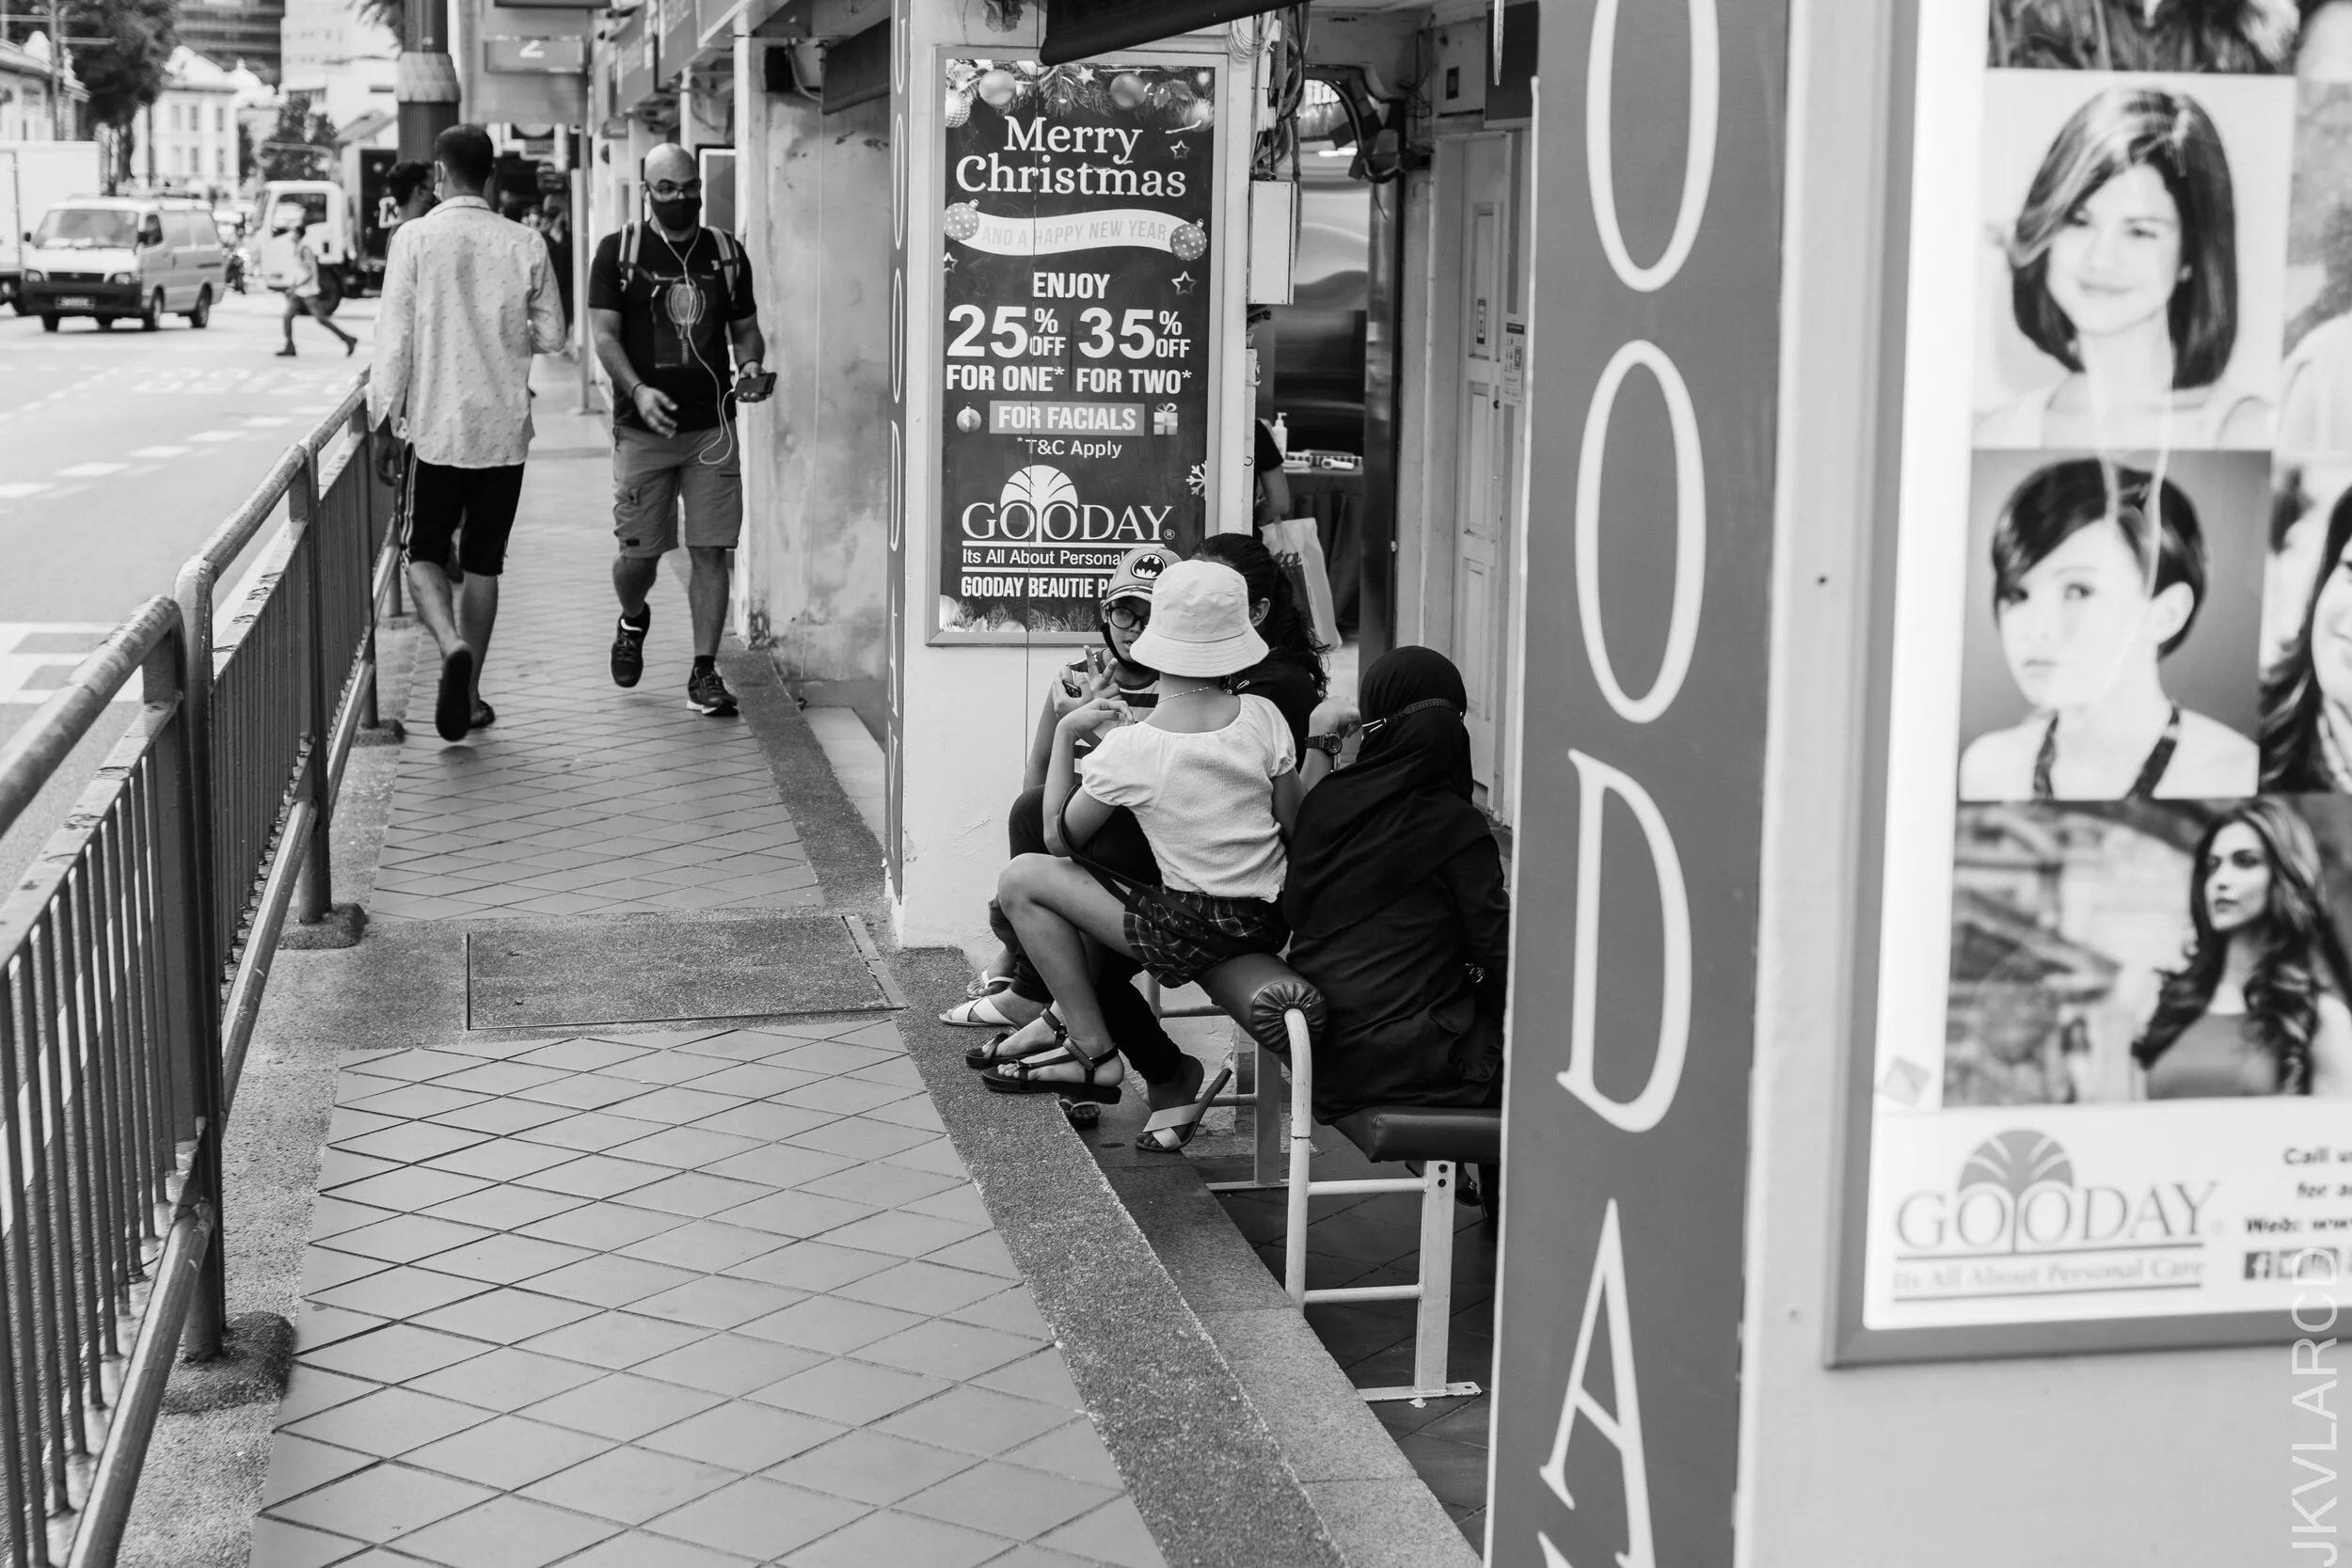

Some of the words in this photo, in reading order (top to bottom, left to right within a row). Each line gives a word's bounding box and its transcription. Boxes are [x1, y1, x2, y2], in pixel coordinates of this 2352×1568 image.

[1004, 116, 1143, 165] Merry
[956, 152, 1186, 198] Christmas
[982, 227, 1012, 246] AND
[1017, 230, 1027, 246] A
[1033, 224, 1084, 245] HAPPY
[1089, 219, 1122, 240] NEW
[1129, 219, 1167, 242] YEAR
[1033, 272, 1110, 299] ENJOY
[1029, 336, 1066, 356] OFF
[1155, 338, 1191, 358] OFF
[946, 365, 995, 391] FOR
[1076, 368, 1121, 393] FOR
[998, 405, 1041, 429] FOR
[1047, 406, 1136, 431] FACIALS
[1071, 440, 1122, 458] Apply
[963, 548, 981, 563] Its
[986, 549, 1005, 564] All
[1009, 549, 1055, 565] About
[1060, 549, 1124, 565] Personal
[961, 576, 1025, 598] GOODAY
[1028, 577, 1093, 598] BEAUTIE
[1098, 578, 1114, 598] P
[2283, 1146, 2329, 1165] Call
[1895, 1181, 2218, 1251] GOODAY
[1931, 1265, 1963, 1288] All
[1968, 1265, 2040, 1287] About
[2049, 1257, 2144, 1282] Personal
[2151, 1256, 2205, 1279] Care
